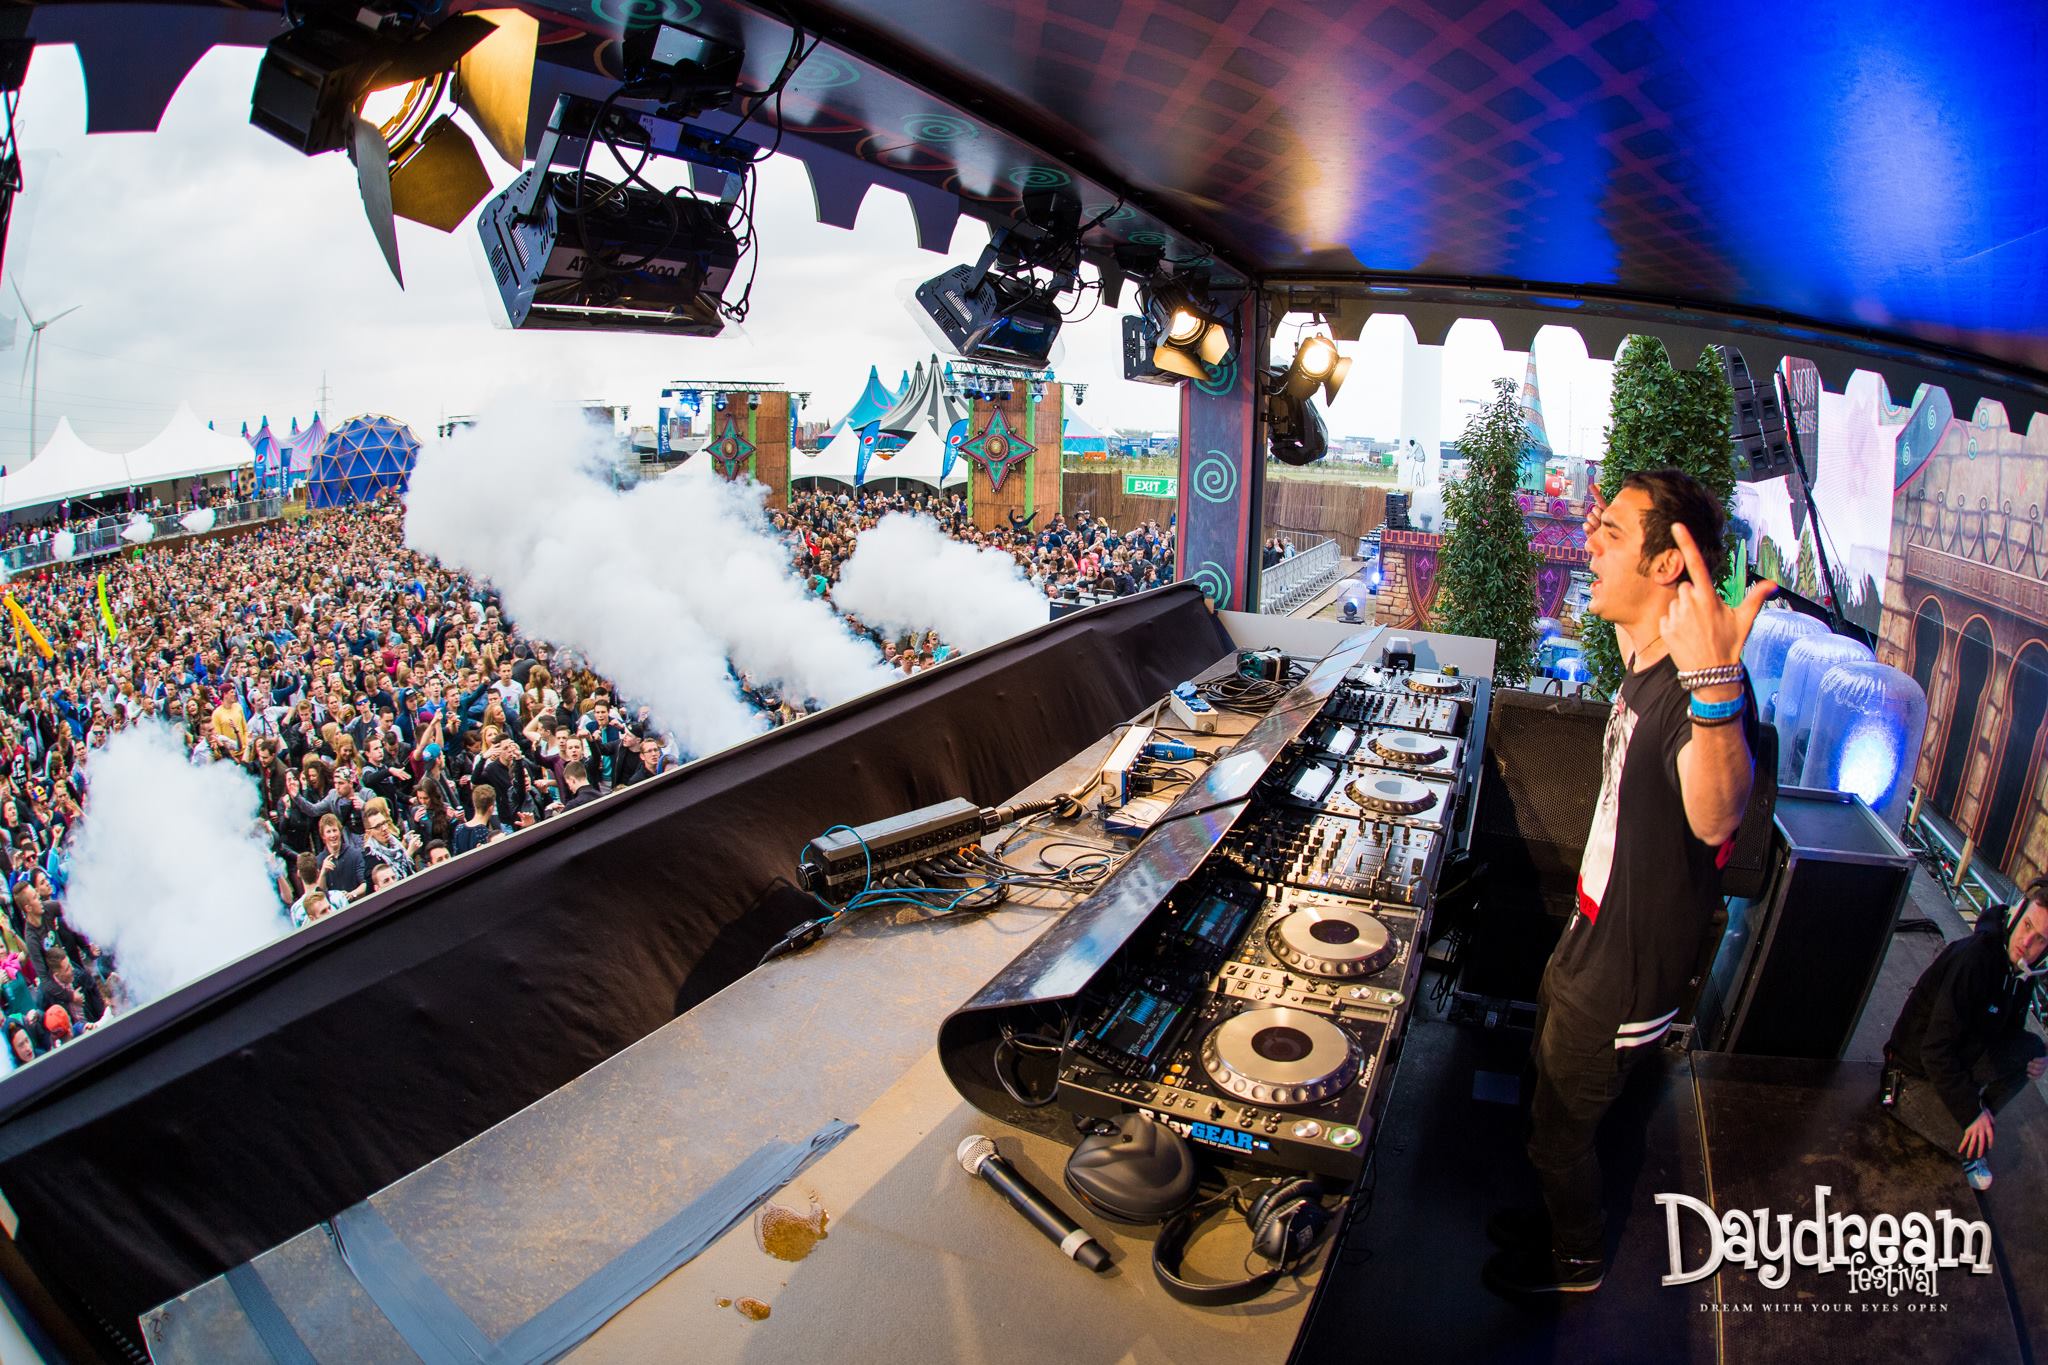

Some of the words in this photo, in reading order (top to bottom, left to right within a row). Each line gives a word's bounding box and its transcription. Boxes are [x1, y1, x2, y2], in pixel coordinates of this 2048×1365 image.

[1135, 480, 1160, 492] EXIT
[1399, 940, 1410, 965] Pioneer
[1358, 1054, 1376, 1088] Pioneer
